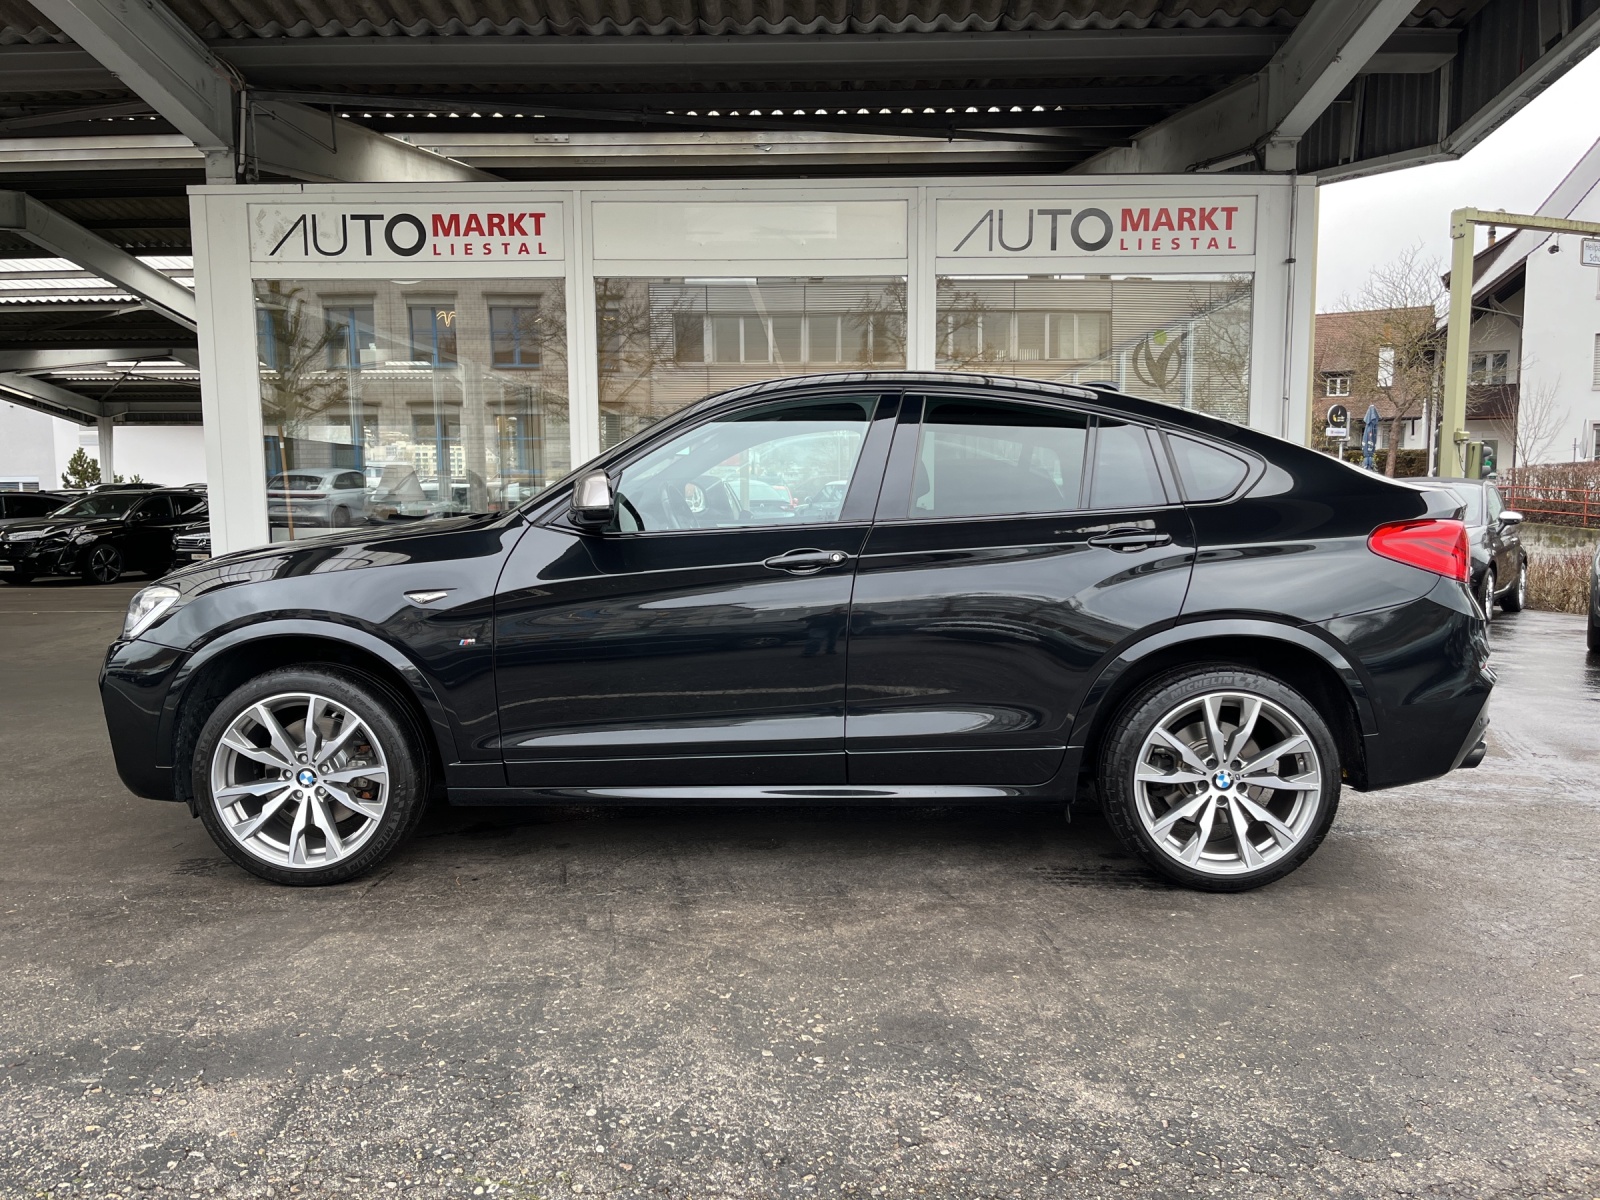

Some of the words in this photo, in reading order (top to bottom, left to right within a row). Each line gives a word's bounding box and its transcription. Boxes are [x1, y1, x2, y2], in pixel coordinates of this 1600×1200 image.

[268, 213, 427, 257] AUTO
[431, 212, 546, 237] MARKT
[952, 207, 1114, 252] AUTO
[1120, 206, 1239, 232] MARKT
[1119, 237, 1237, 251] LIESTAL
[432, 242, 547, 256] LIESTAL
[328, 682, 350, 695] Pilot
[351, 694, 374, 712] Super
[1169, 676, 1234, 700] MICHELIN
[349, 826, 394, 872] MICHELIN
